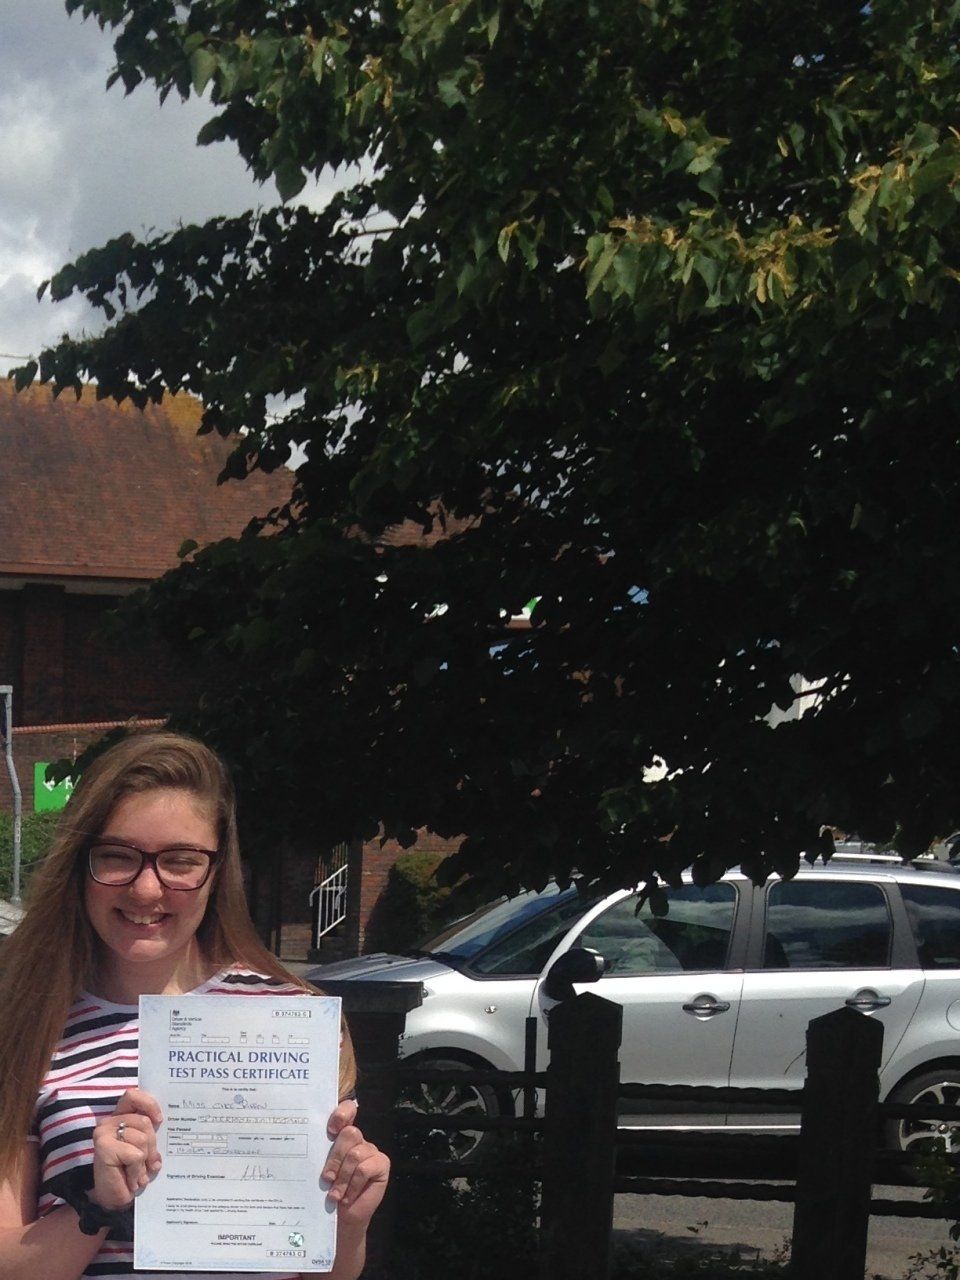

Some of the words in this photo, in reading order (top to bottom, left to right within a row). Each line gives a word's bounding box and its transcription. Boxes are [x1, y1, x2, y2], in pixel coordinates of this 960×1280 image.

[168, 1050, 243, 1063] PRACTICAL
[248, 1051, 309, 1063] DRIVING
[169, 1067, 196, 1078] TEST
[200, 1068, 229, 1079] PASS
[233, 1069, 309, 1080] CERTIFICATE
